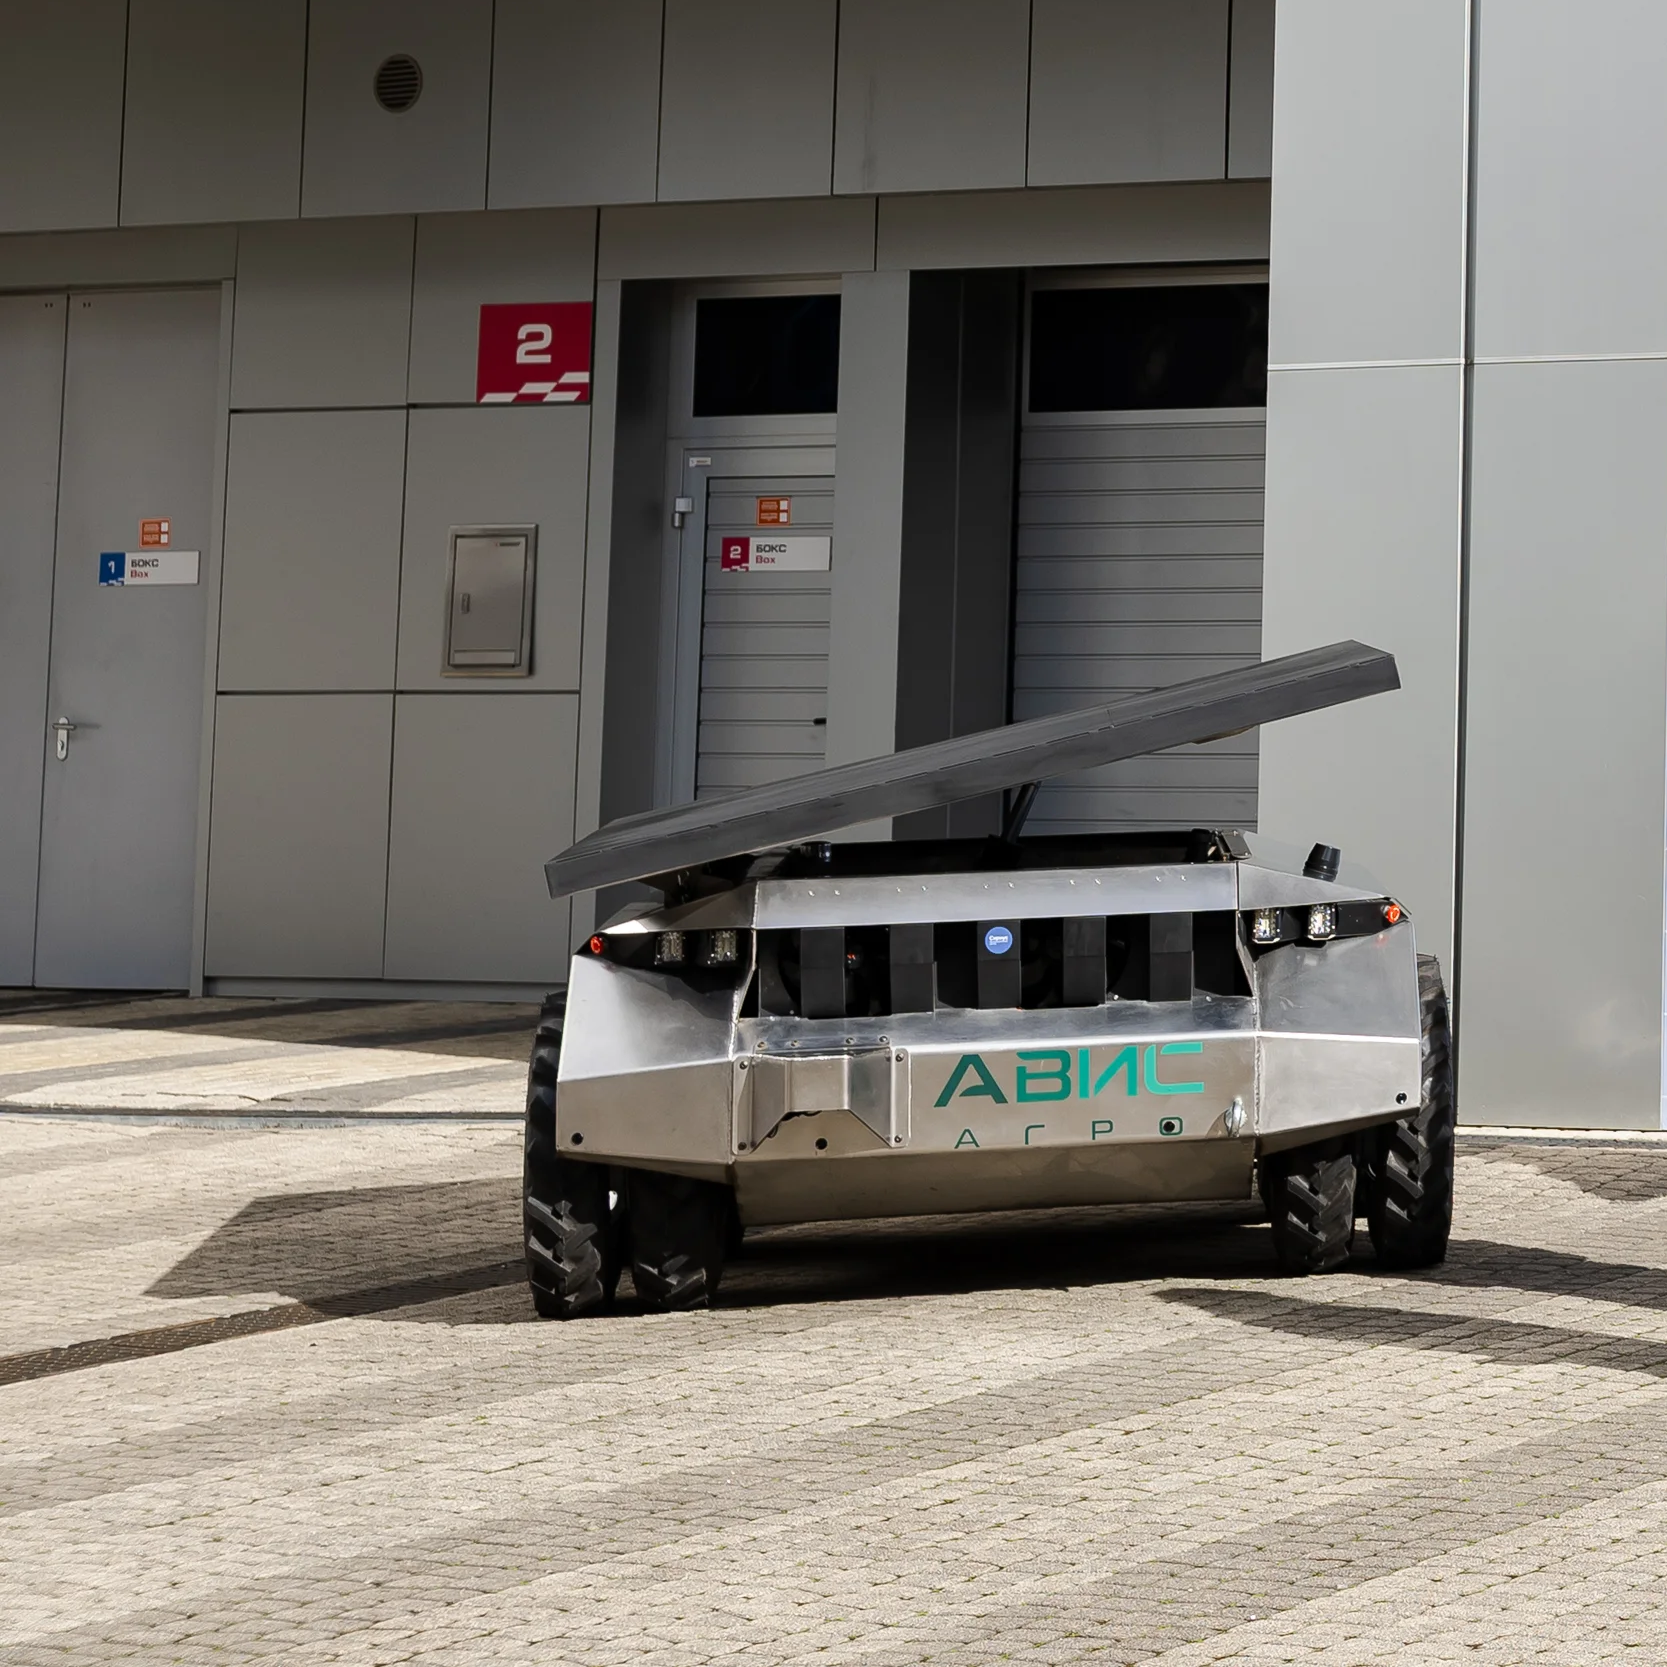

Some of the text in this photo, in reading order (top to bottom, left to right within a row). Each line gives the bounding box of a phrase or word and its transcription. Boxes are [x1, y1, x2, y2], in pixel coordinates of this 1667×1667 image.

[515, 322, 553, 365] 2
[729, 545, 742, 559] 2
[755, 543, 788, 553] БОКС
[130, 558, 160, 568] БОКС
[755, 555, 776, 564] Box
[107, 560, 116, 574] 1
[130, 569, 149, 578] Box
[933, 1041, 1205, 1108] АВИС
[954, 1116, 1184, 1149] АГРО
